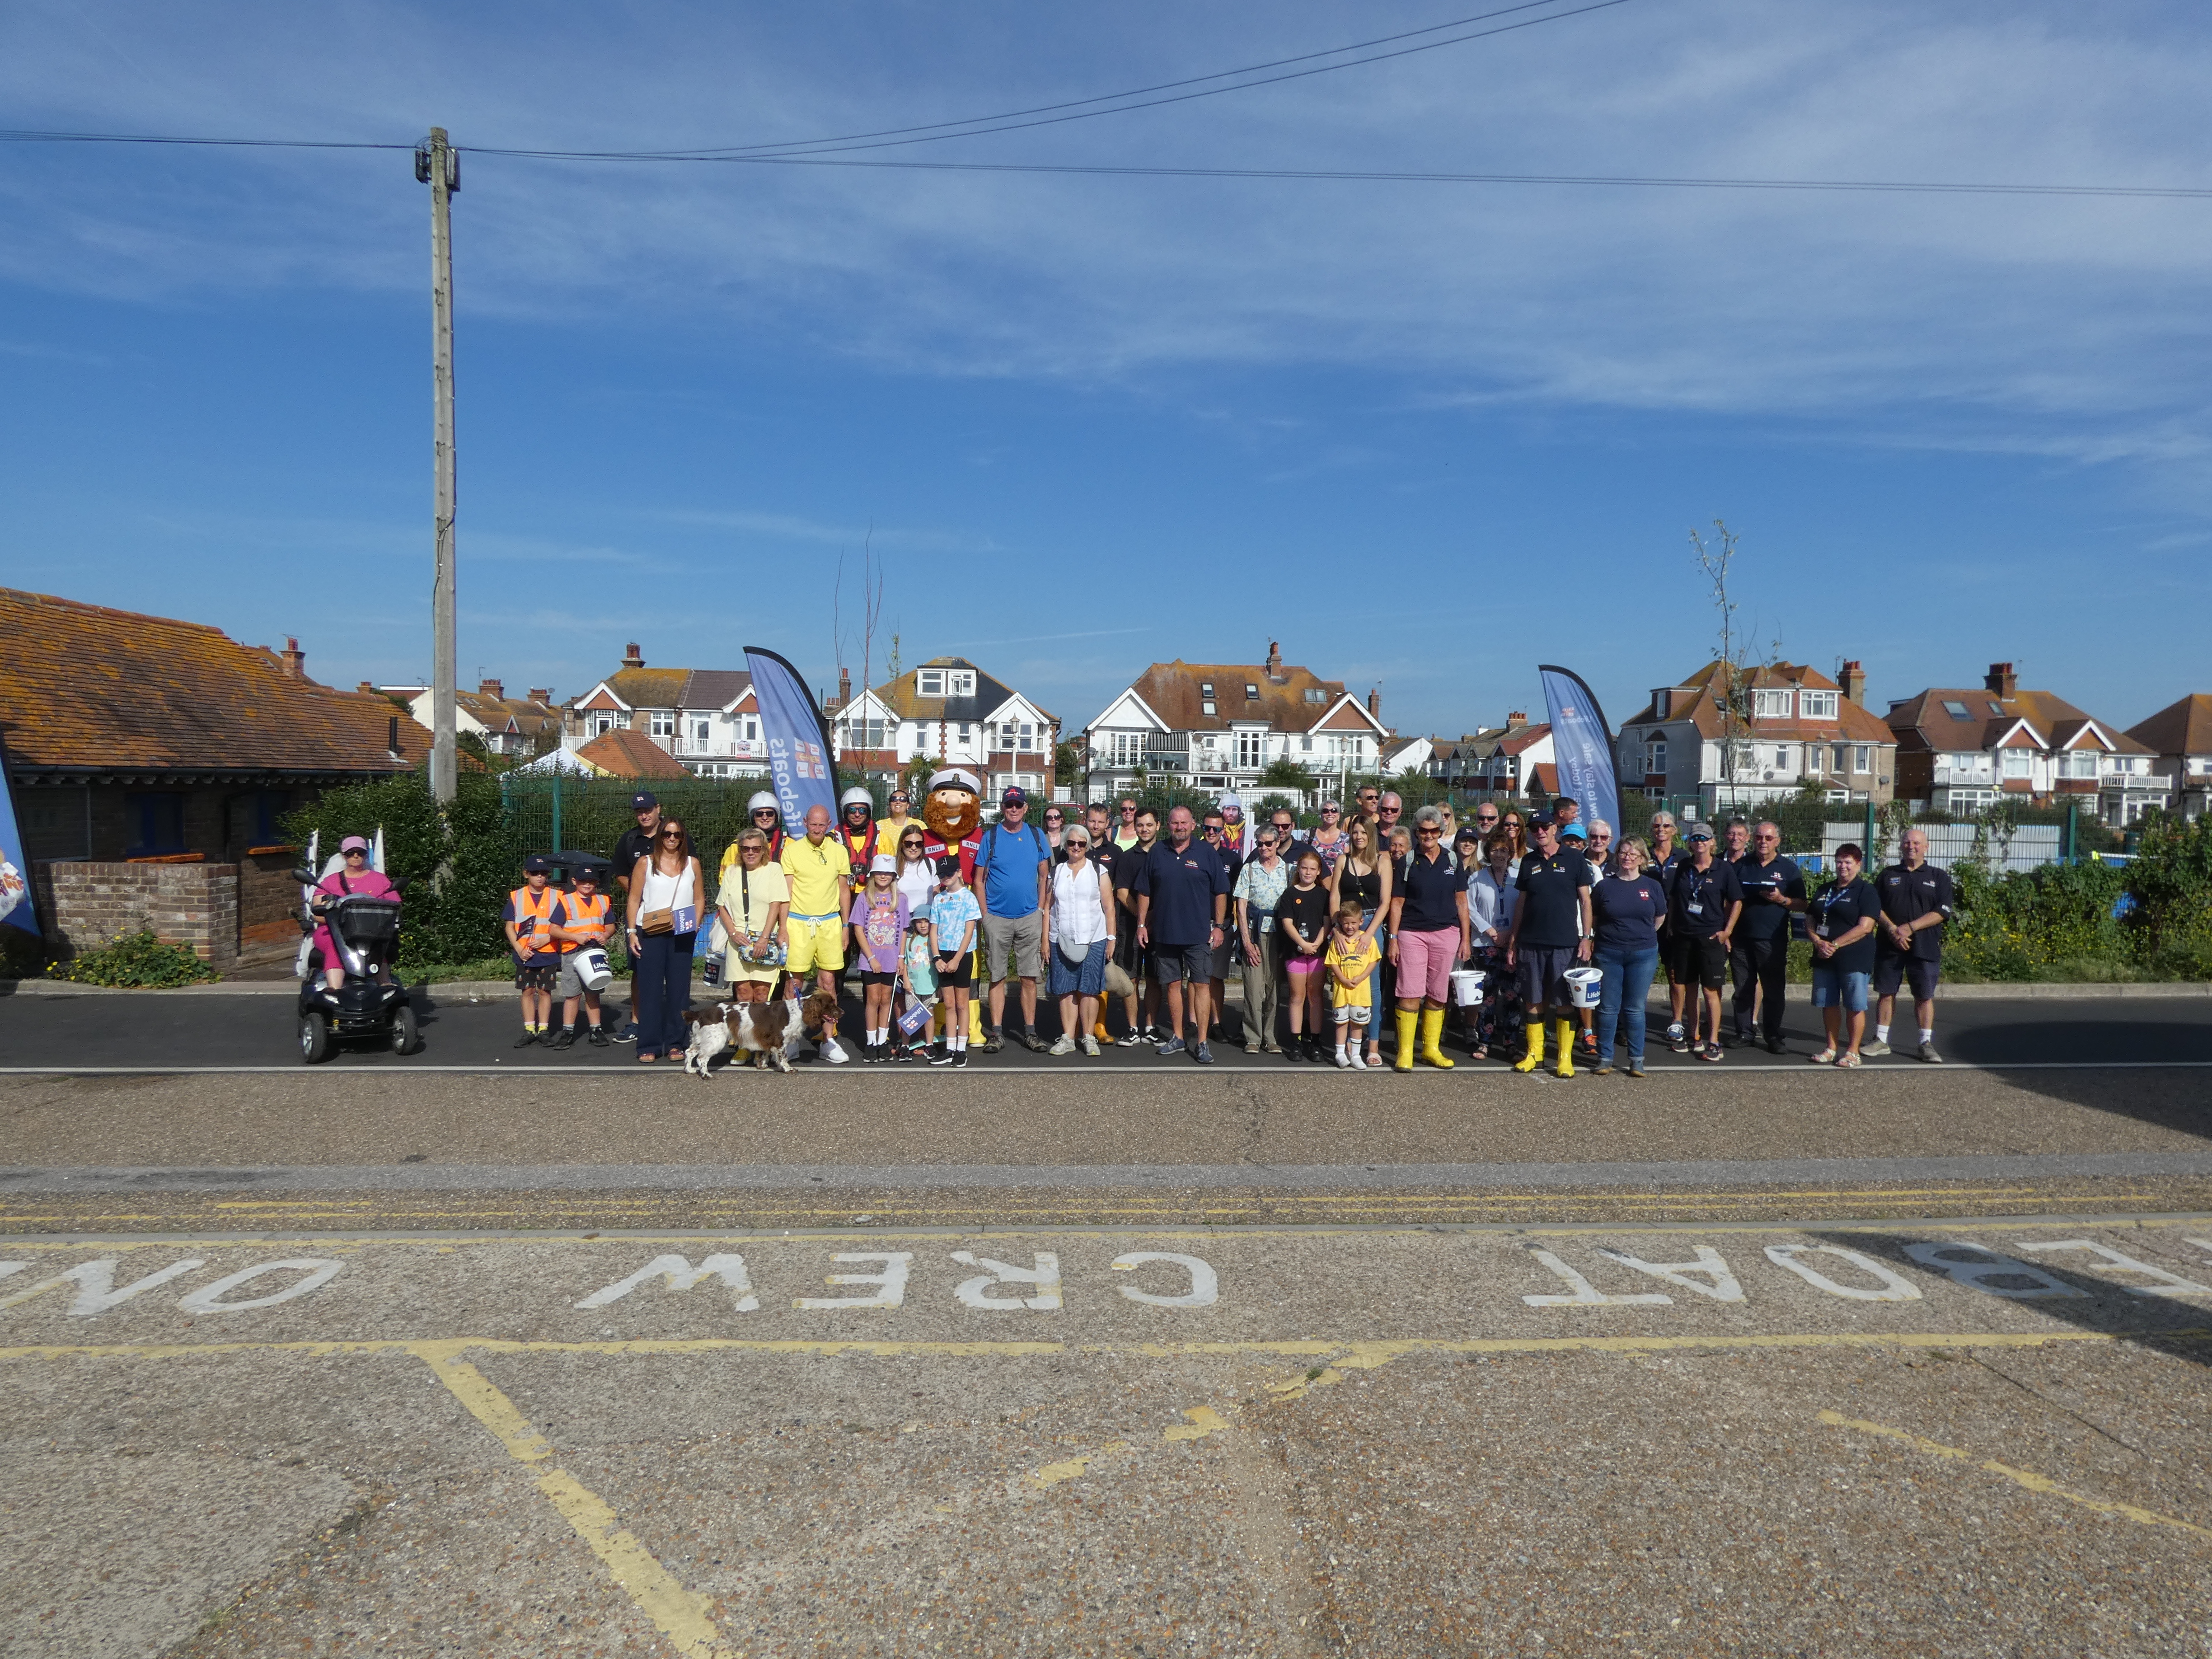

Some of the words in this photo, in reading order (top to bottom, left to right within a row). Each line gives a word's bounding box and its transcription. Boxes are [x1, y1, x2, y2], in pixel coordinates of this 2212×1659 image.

[903, 1007, 923, 1025] Lifeboats
[0, 1259, 346, 1316] ON
[574, 1250, 1218, 1311] CREW
[1521, 1237, 2212, 1307] EBOAT
